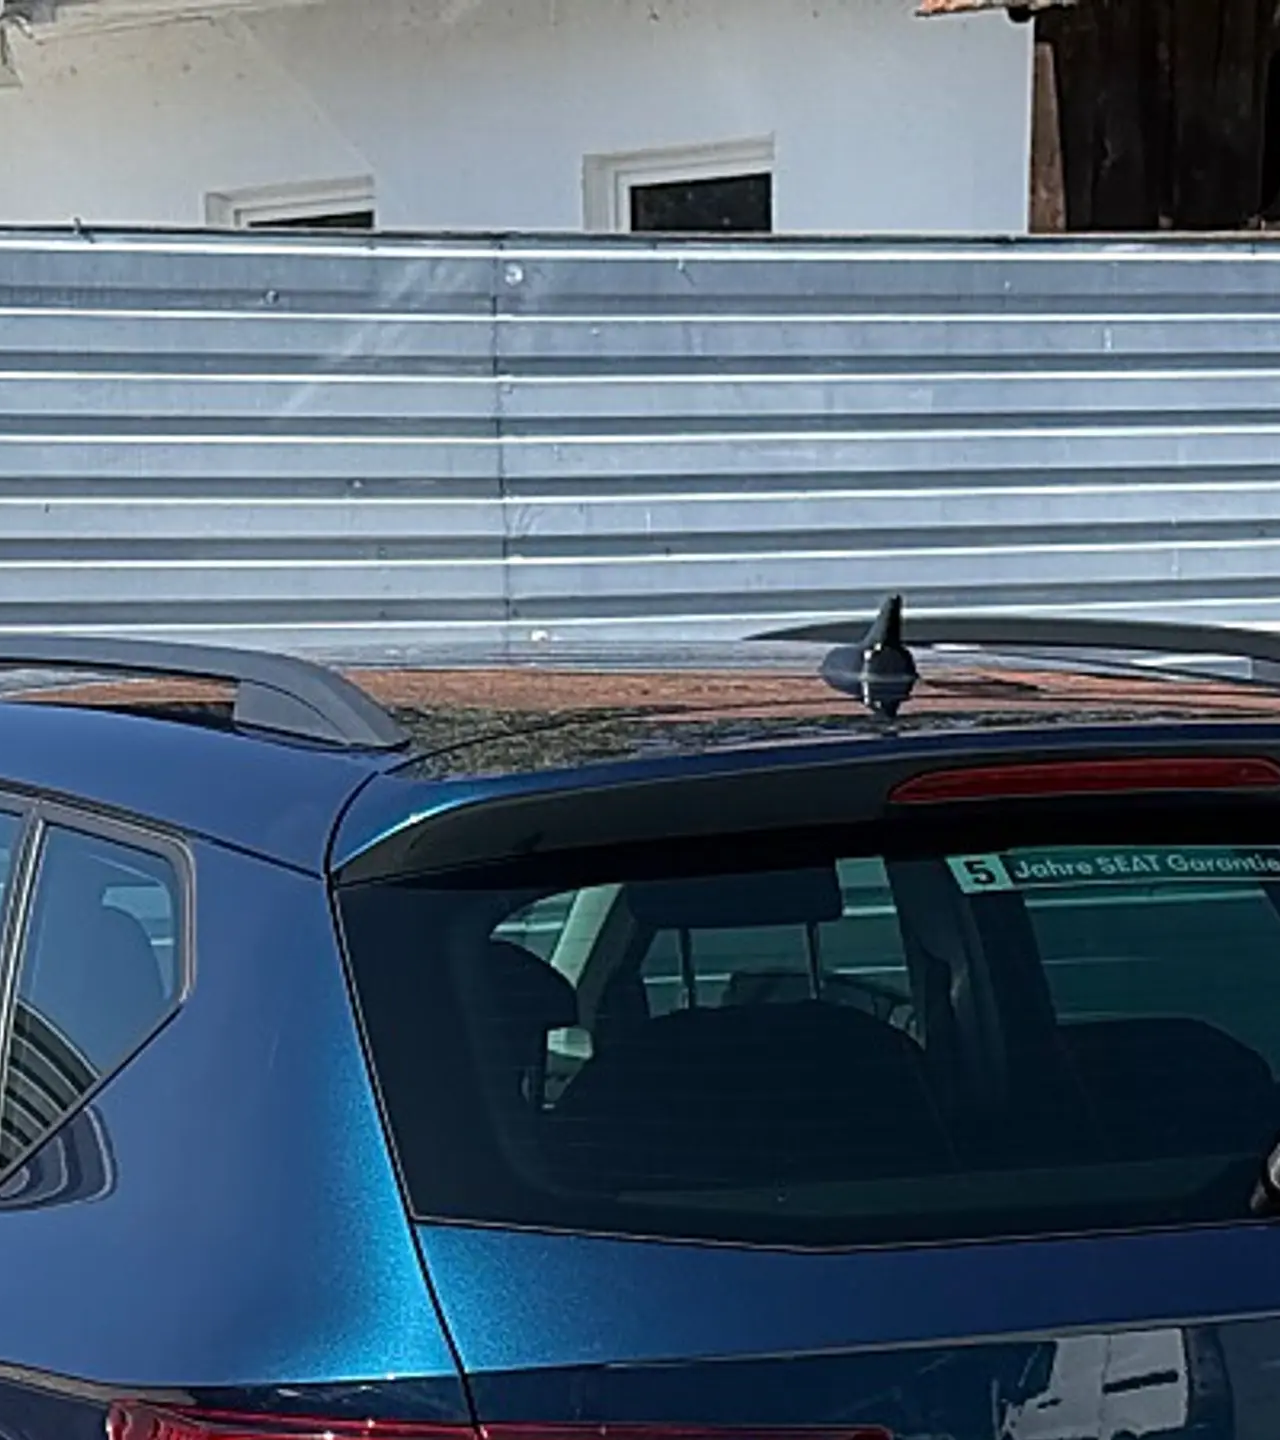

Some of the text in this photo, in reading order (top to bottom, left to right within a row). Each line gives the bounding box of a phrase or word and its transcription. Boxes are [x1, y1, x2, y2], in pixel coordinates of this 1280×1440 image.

[963, 860, 997, 884] 5
[1015, 860, 1094, 879] Jahre
[1095, 854, 1161, 874] SEAT
